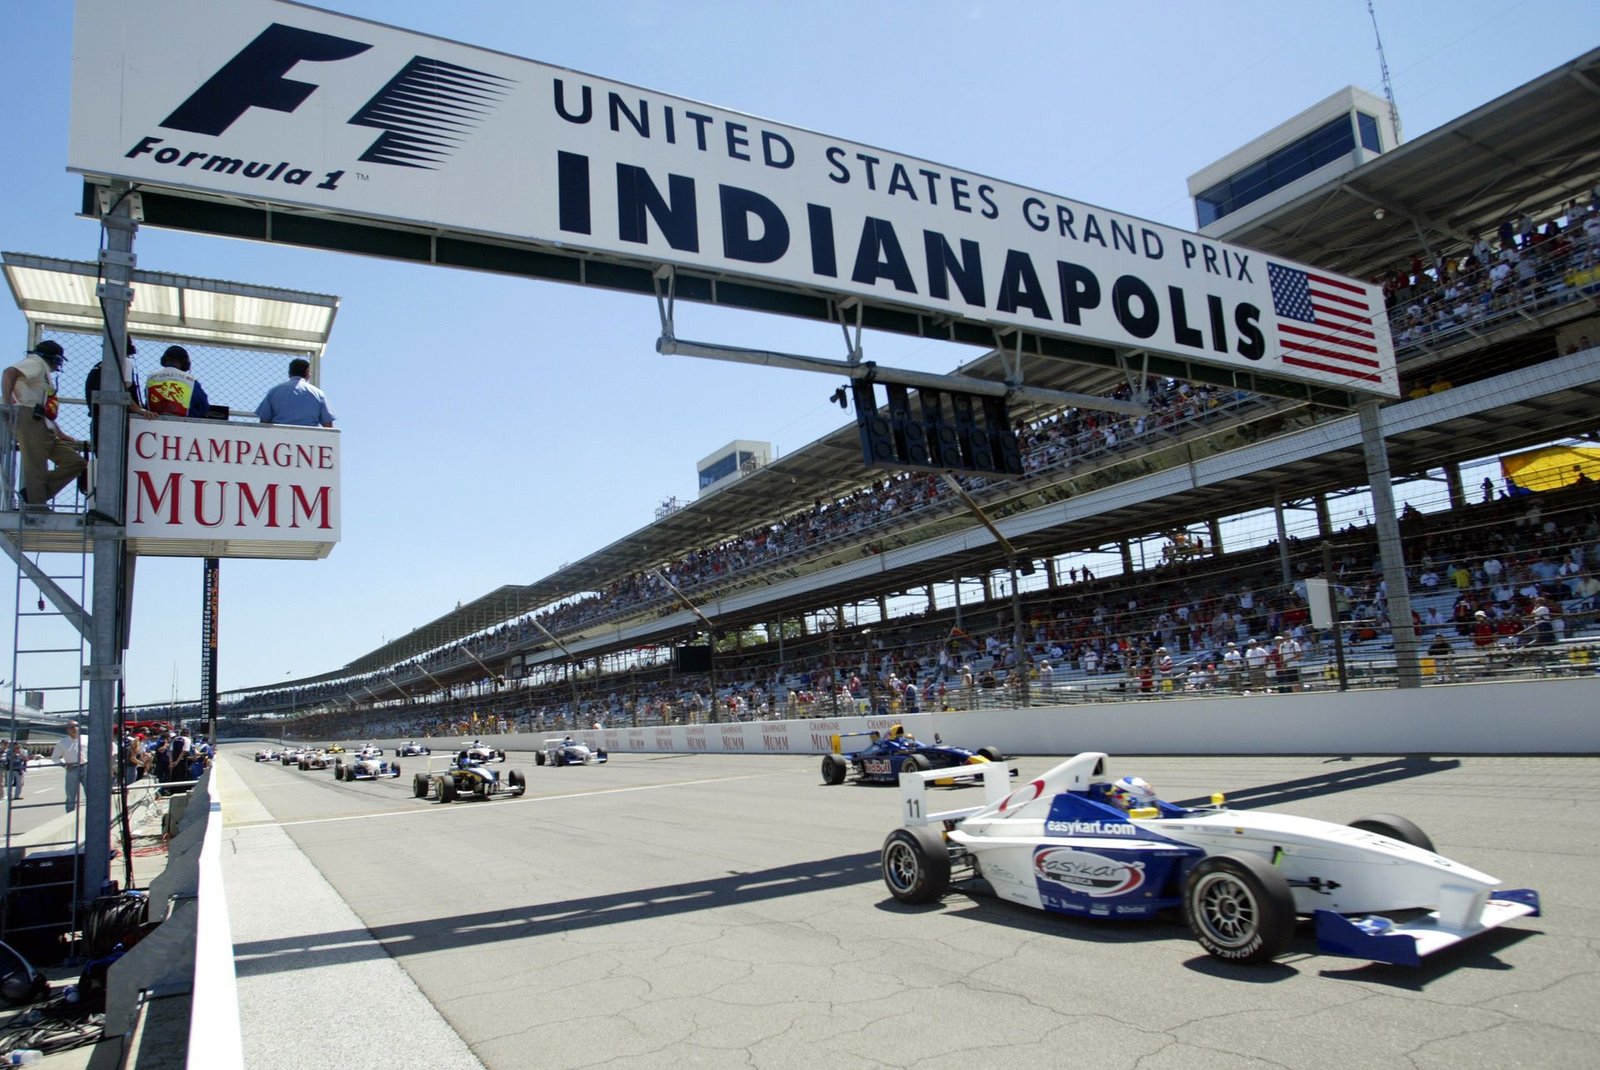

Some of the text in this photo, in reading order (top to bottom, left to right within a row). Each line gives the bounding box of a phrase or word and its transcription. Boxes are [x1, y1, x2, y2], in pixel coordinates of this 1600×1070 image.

[124, 136, 312, 186] Formula
[315, 170, 346, 191] 1
[553, 78, 1254, 284] UNITED STATES GRAND PRIX
[557, 150, 1265, 361] INDIANAPOLIS
[135, 431, 334, 470] CHAMPAGNE
[132, 470, 334, 529] MUMM
[810, 721, 839, 731] CHAMPAGNE
[763, 735, 788, 751] MUMM
[811, 733, 832, 750] MUM
[906, 798, 920, 819] 11
[1047, 820, 1136, 836] easykart.com
[1200, 932, 1264, 959] MICHELIN
